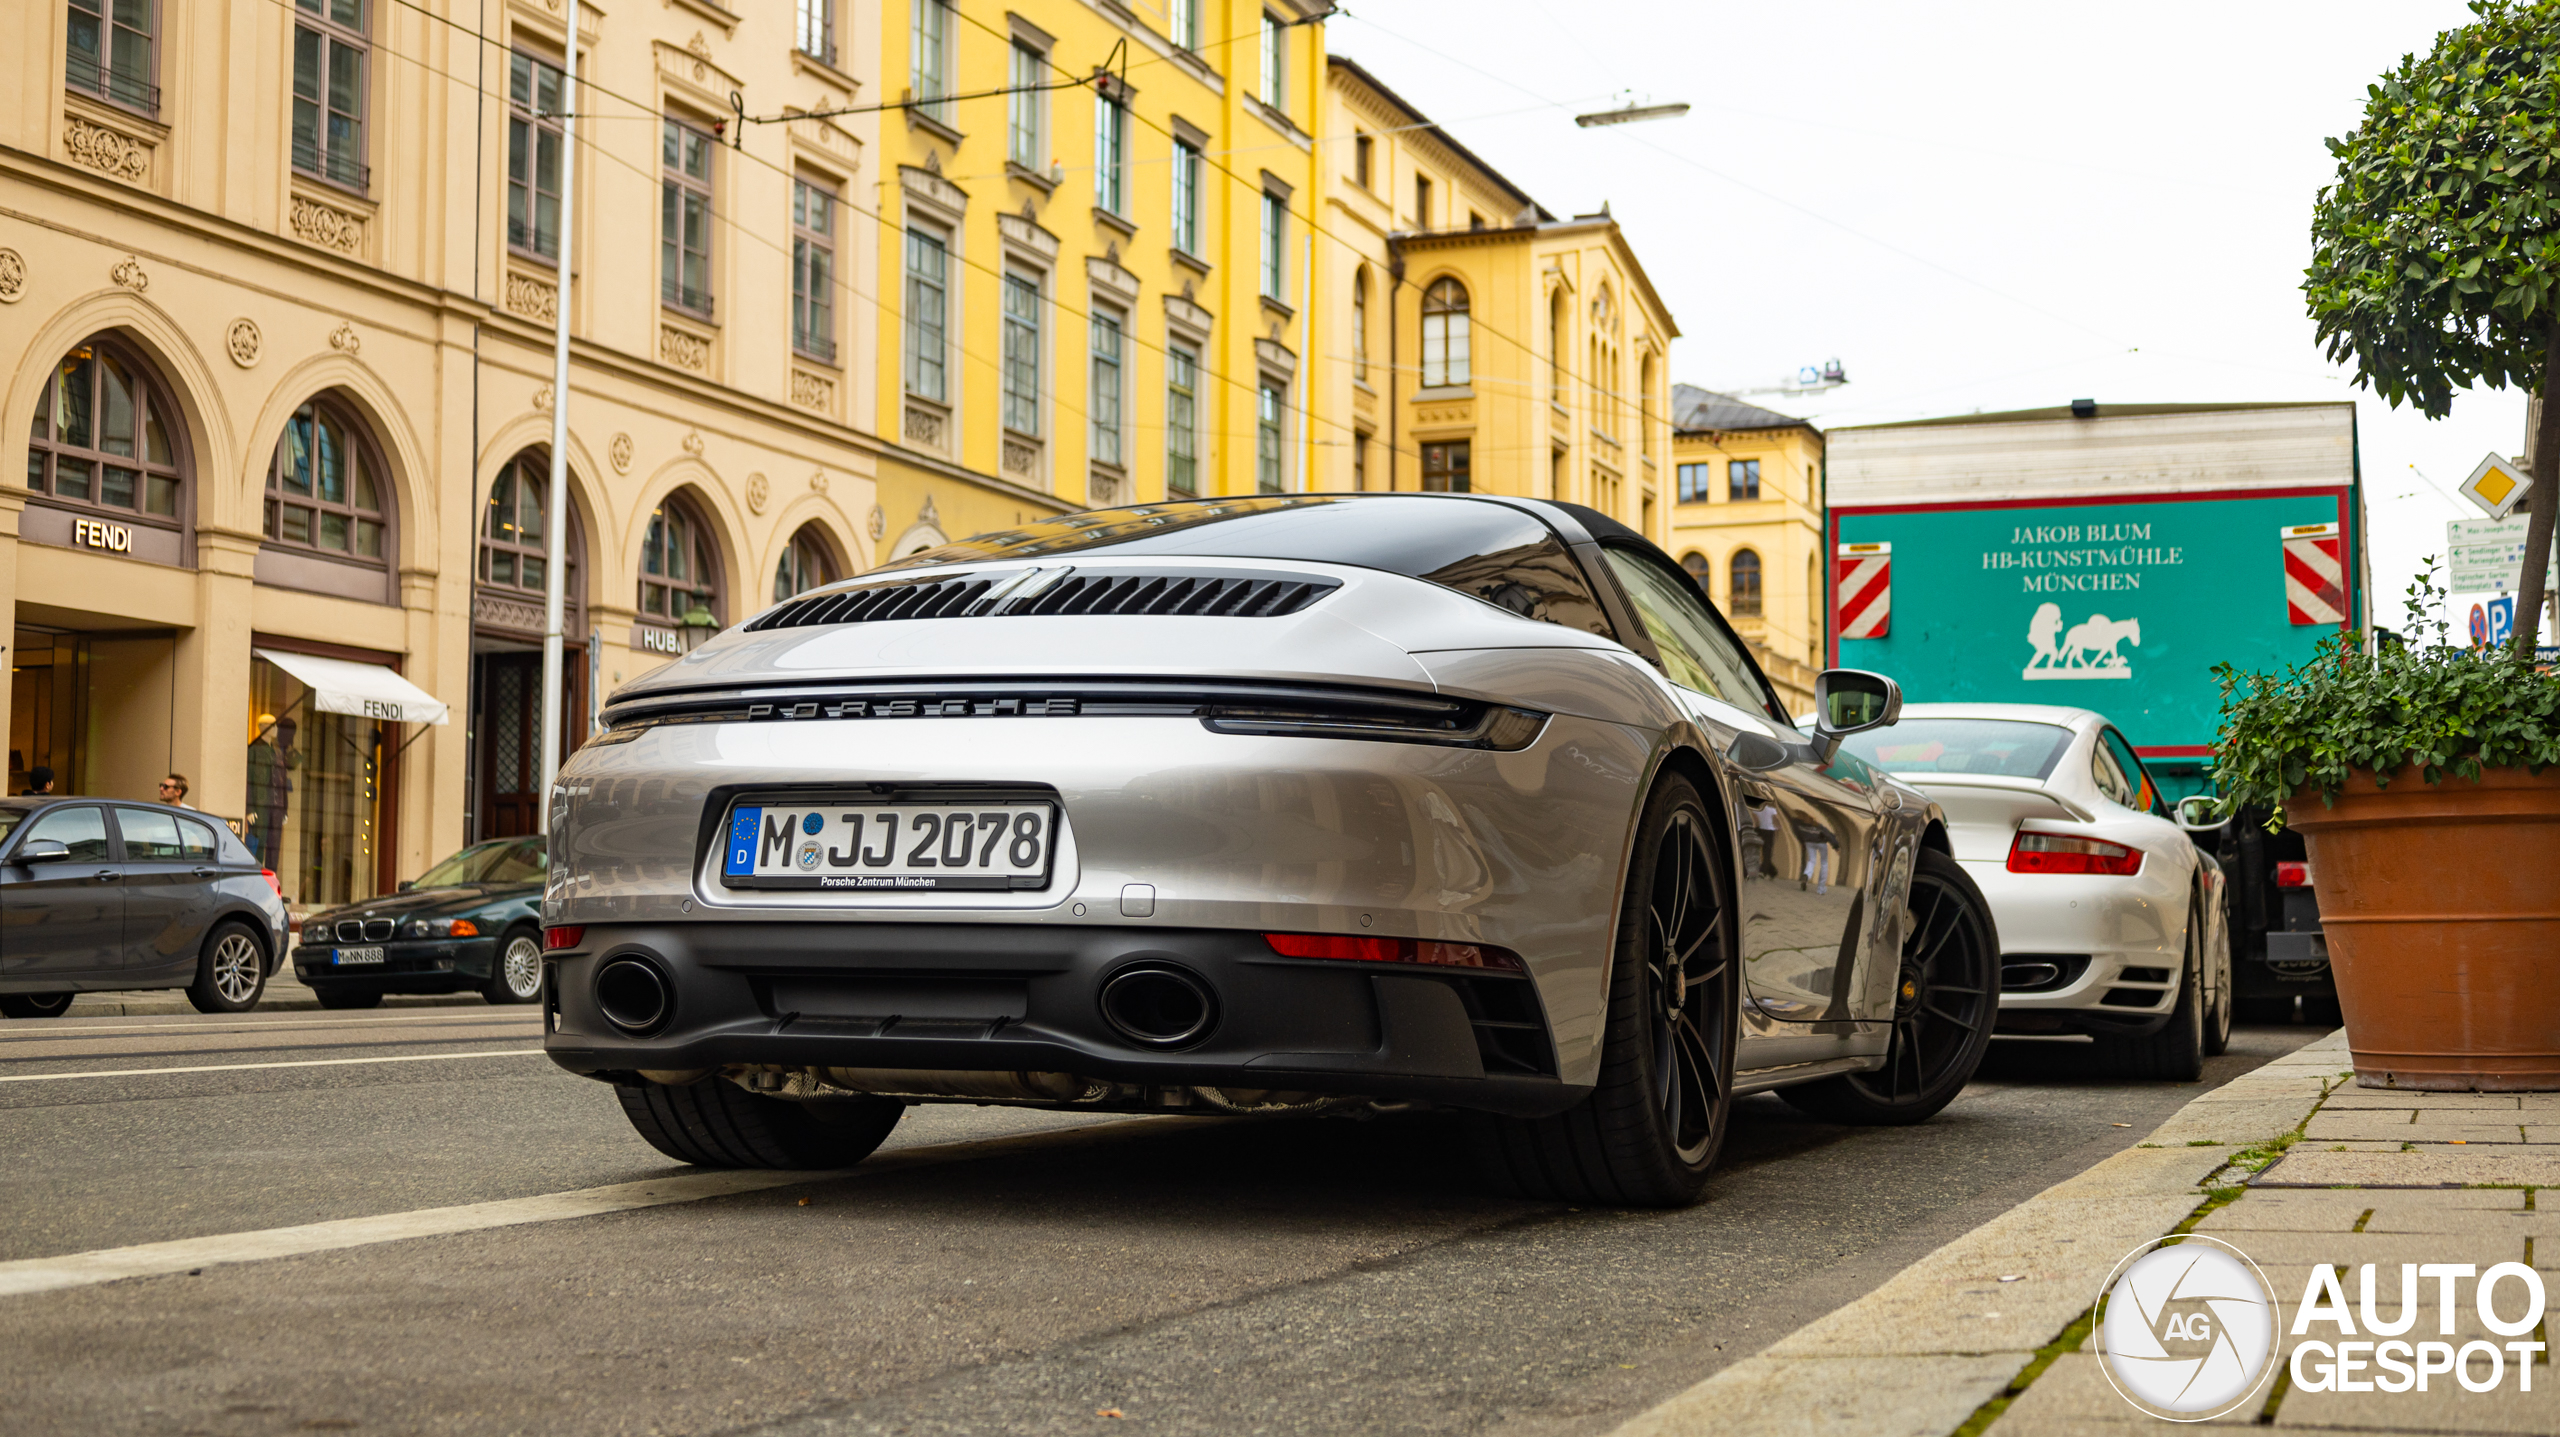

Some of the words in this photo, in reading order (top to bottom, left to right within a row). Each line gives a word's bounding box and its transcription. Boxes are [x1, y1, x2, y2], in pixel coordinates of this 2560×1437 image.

[76, 518, 132, 553] FENDI
[2011, 525, 2081, 544] JAKOB
[2087, 523, 2151, 542] BLUM
[1982, 545, 2184, 569] HB-KUNSTMÜHLE
[2022, 572, 2141, 593] MÜNCHEN
[2491, 604, 2506, 645] P
[364, 699, 403, 720] FENDI
[748, 698, 1077, 721] PORSCHE
[760, 813, 797, 867] M
[828, 813, 899, 868] JJ
[907, 812, 1043, 868] 2078
[736, 849, 748, 865] D
[820, 876, 857, 887] Porsche
[857, 876, 894, 887] Zentrum
[894, 876, 936, 887] München
[338, 951, 345, 962] M
[364, 949, 383, 961] 888
